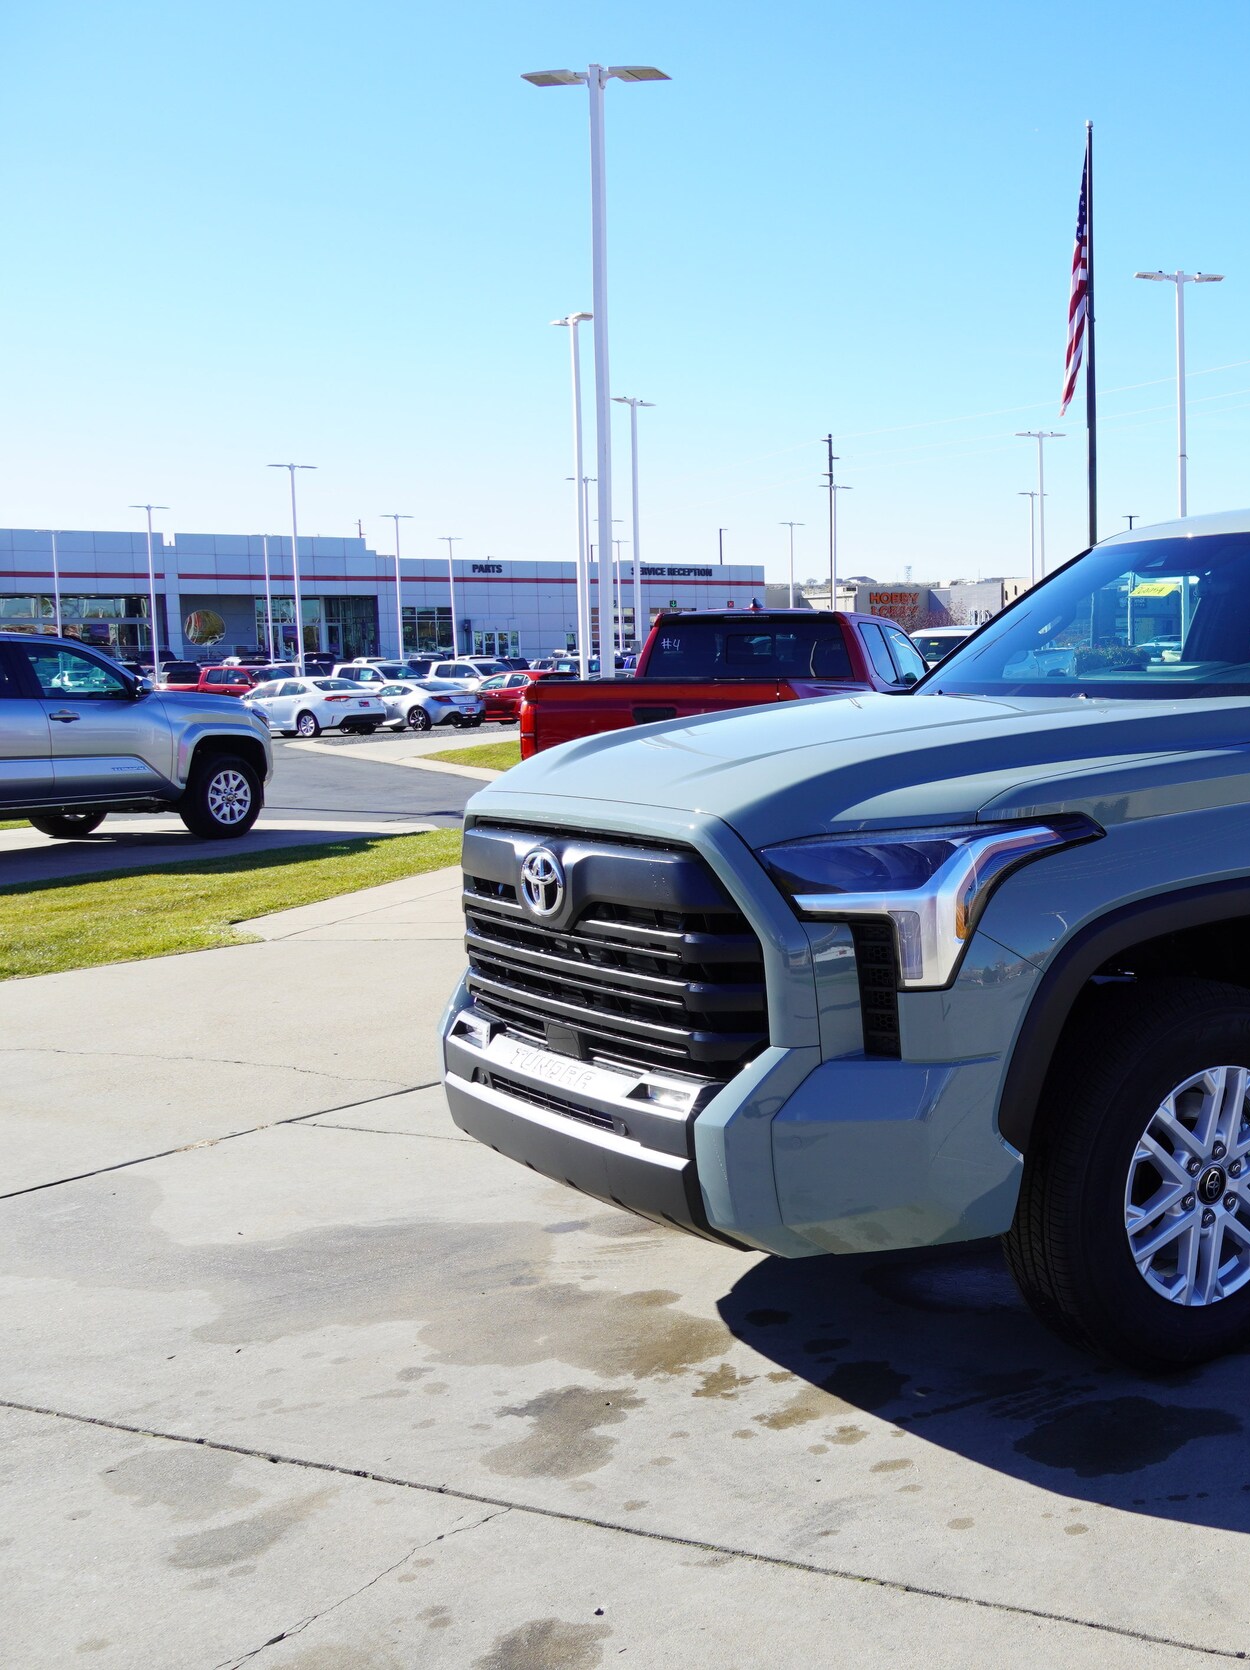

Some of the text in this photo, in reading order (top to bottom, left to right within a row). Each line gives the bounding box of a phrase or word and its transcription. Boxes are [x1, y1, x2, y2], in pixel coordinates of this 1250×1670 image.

[472, 564, 503, 574] PARTS
[667, 567, 713, 577] RECEPTION
[869, 592, 920, 605] HOBBY
[661, 638, 681, 651] #4
[509, 1047, 597, 1090] TUNDRA
